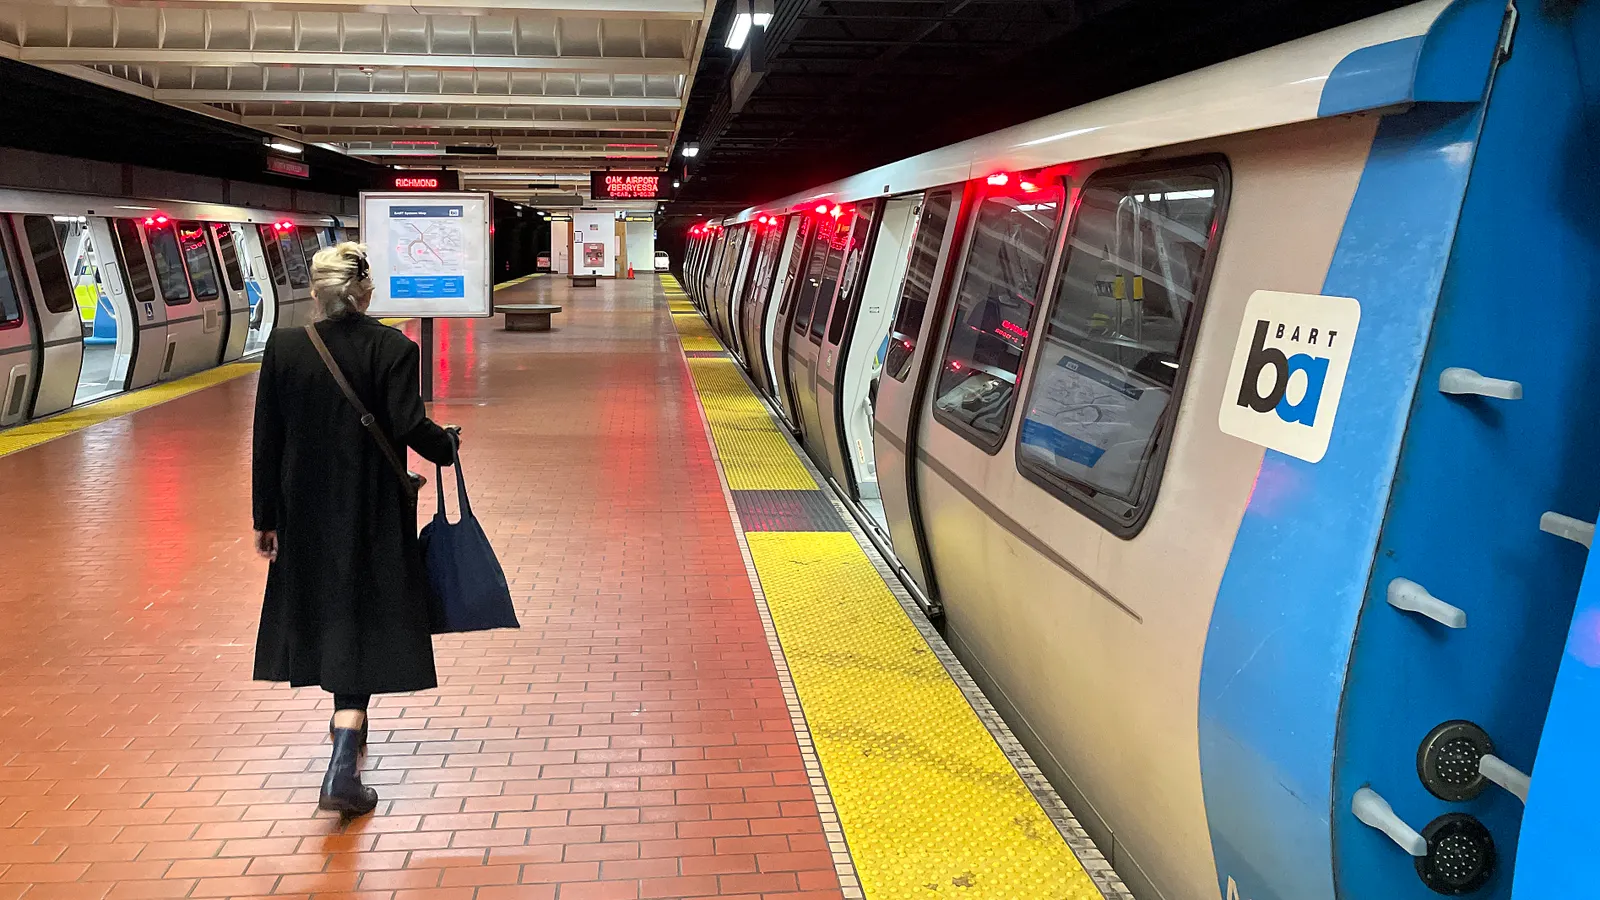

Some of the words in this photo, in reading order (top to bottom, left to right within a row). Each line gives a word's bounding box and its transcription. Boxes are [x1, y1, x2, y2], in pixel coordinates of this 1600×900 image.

[395, 178, 437, 187] RICHMOND
[605, 176, 622, 184] OAK
[626, 176, 659, 184] AIRPORT
[1275, 323, 1338, 348] BART
[1236, 319, 1330, 428] ba
